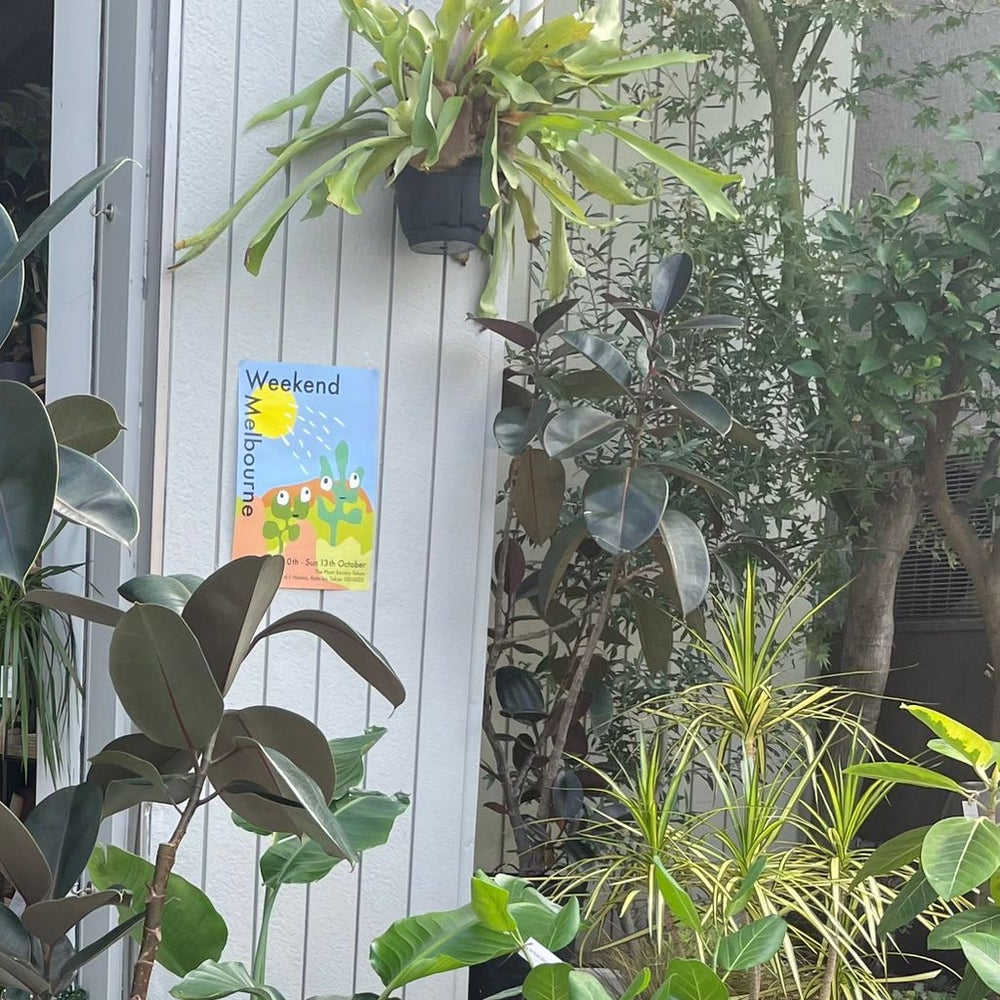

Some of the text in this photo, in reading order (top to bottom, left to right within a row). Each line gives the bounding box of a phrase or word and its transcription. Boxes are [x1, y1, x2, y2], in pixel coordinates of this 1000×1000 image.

[245, 369, 340, 395] Weekend
[241, 394, 263, 517] Melbourne
[286, 558, 299, 566] 0th
[305, 558, 318, 567] Sun
[320, 558, 336, 567] 13th
[337, 559, 367, 569] October
